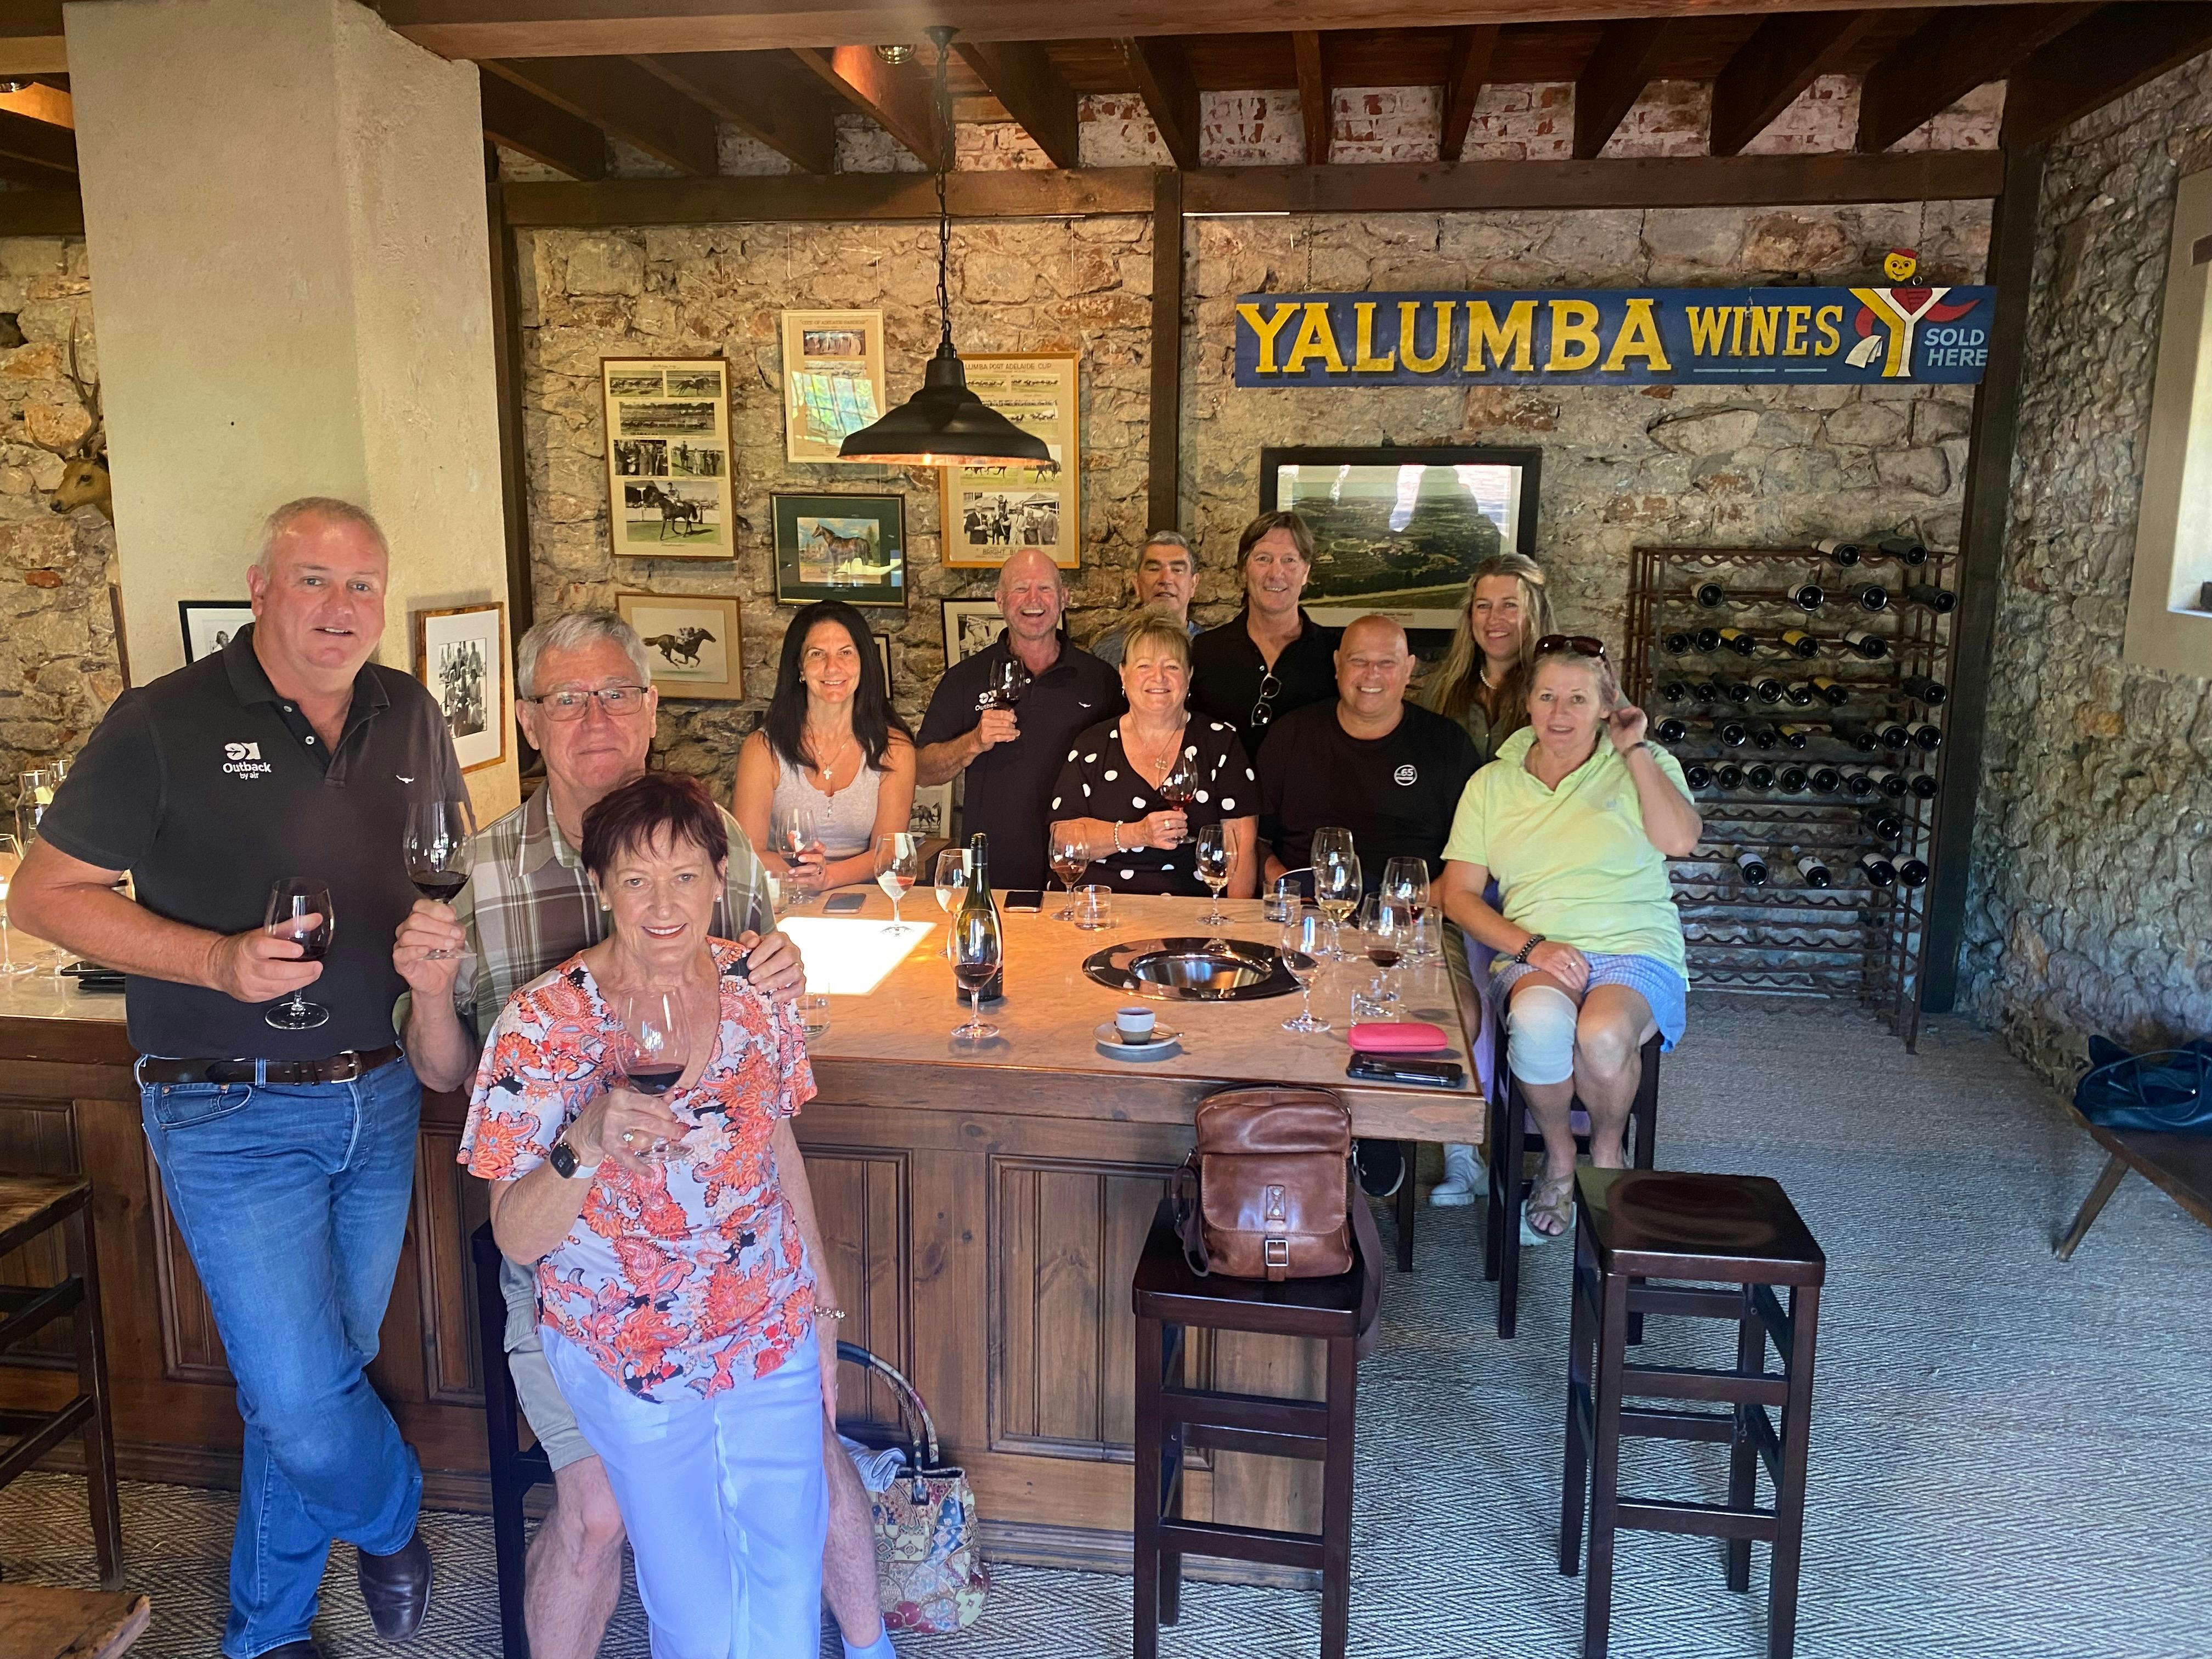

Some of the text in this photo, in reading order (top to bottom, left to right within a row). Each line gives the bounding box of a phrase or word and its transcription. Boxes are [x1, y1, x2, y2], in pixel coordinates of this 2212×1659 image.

[1235, 298, 1843, 374] YALUMBA WINES
[1924, 328, 1985, 346] SOLD
[1927, 348, 1988, 366] HERE
[975, 703, 997, 711] Outbac
[223, 761, 272, 774] Outback
[239, 770, 259, 780] by air
